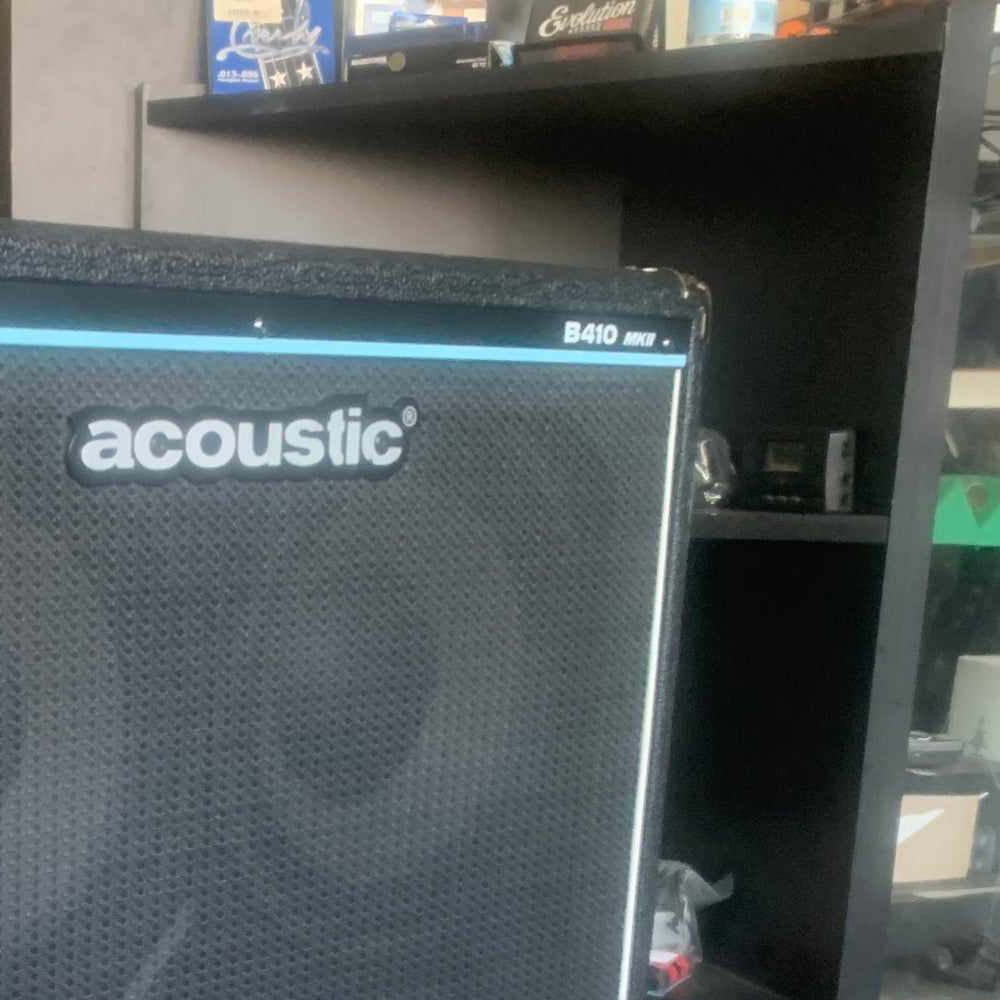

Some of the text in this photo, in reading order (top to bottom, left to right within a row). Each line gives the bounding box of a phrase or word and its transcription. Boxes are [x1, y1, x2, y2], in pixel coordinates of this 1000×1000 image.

[538, 0, 637, 38] Evolution
[563, 320, 656, 347] B410 MKII
[80, 407, 403, 471] acoustic
